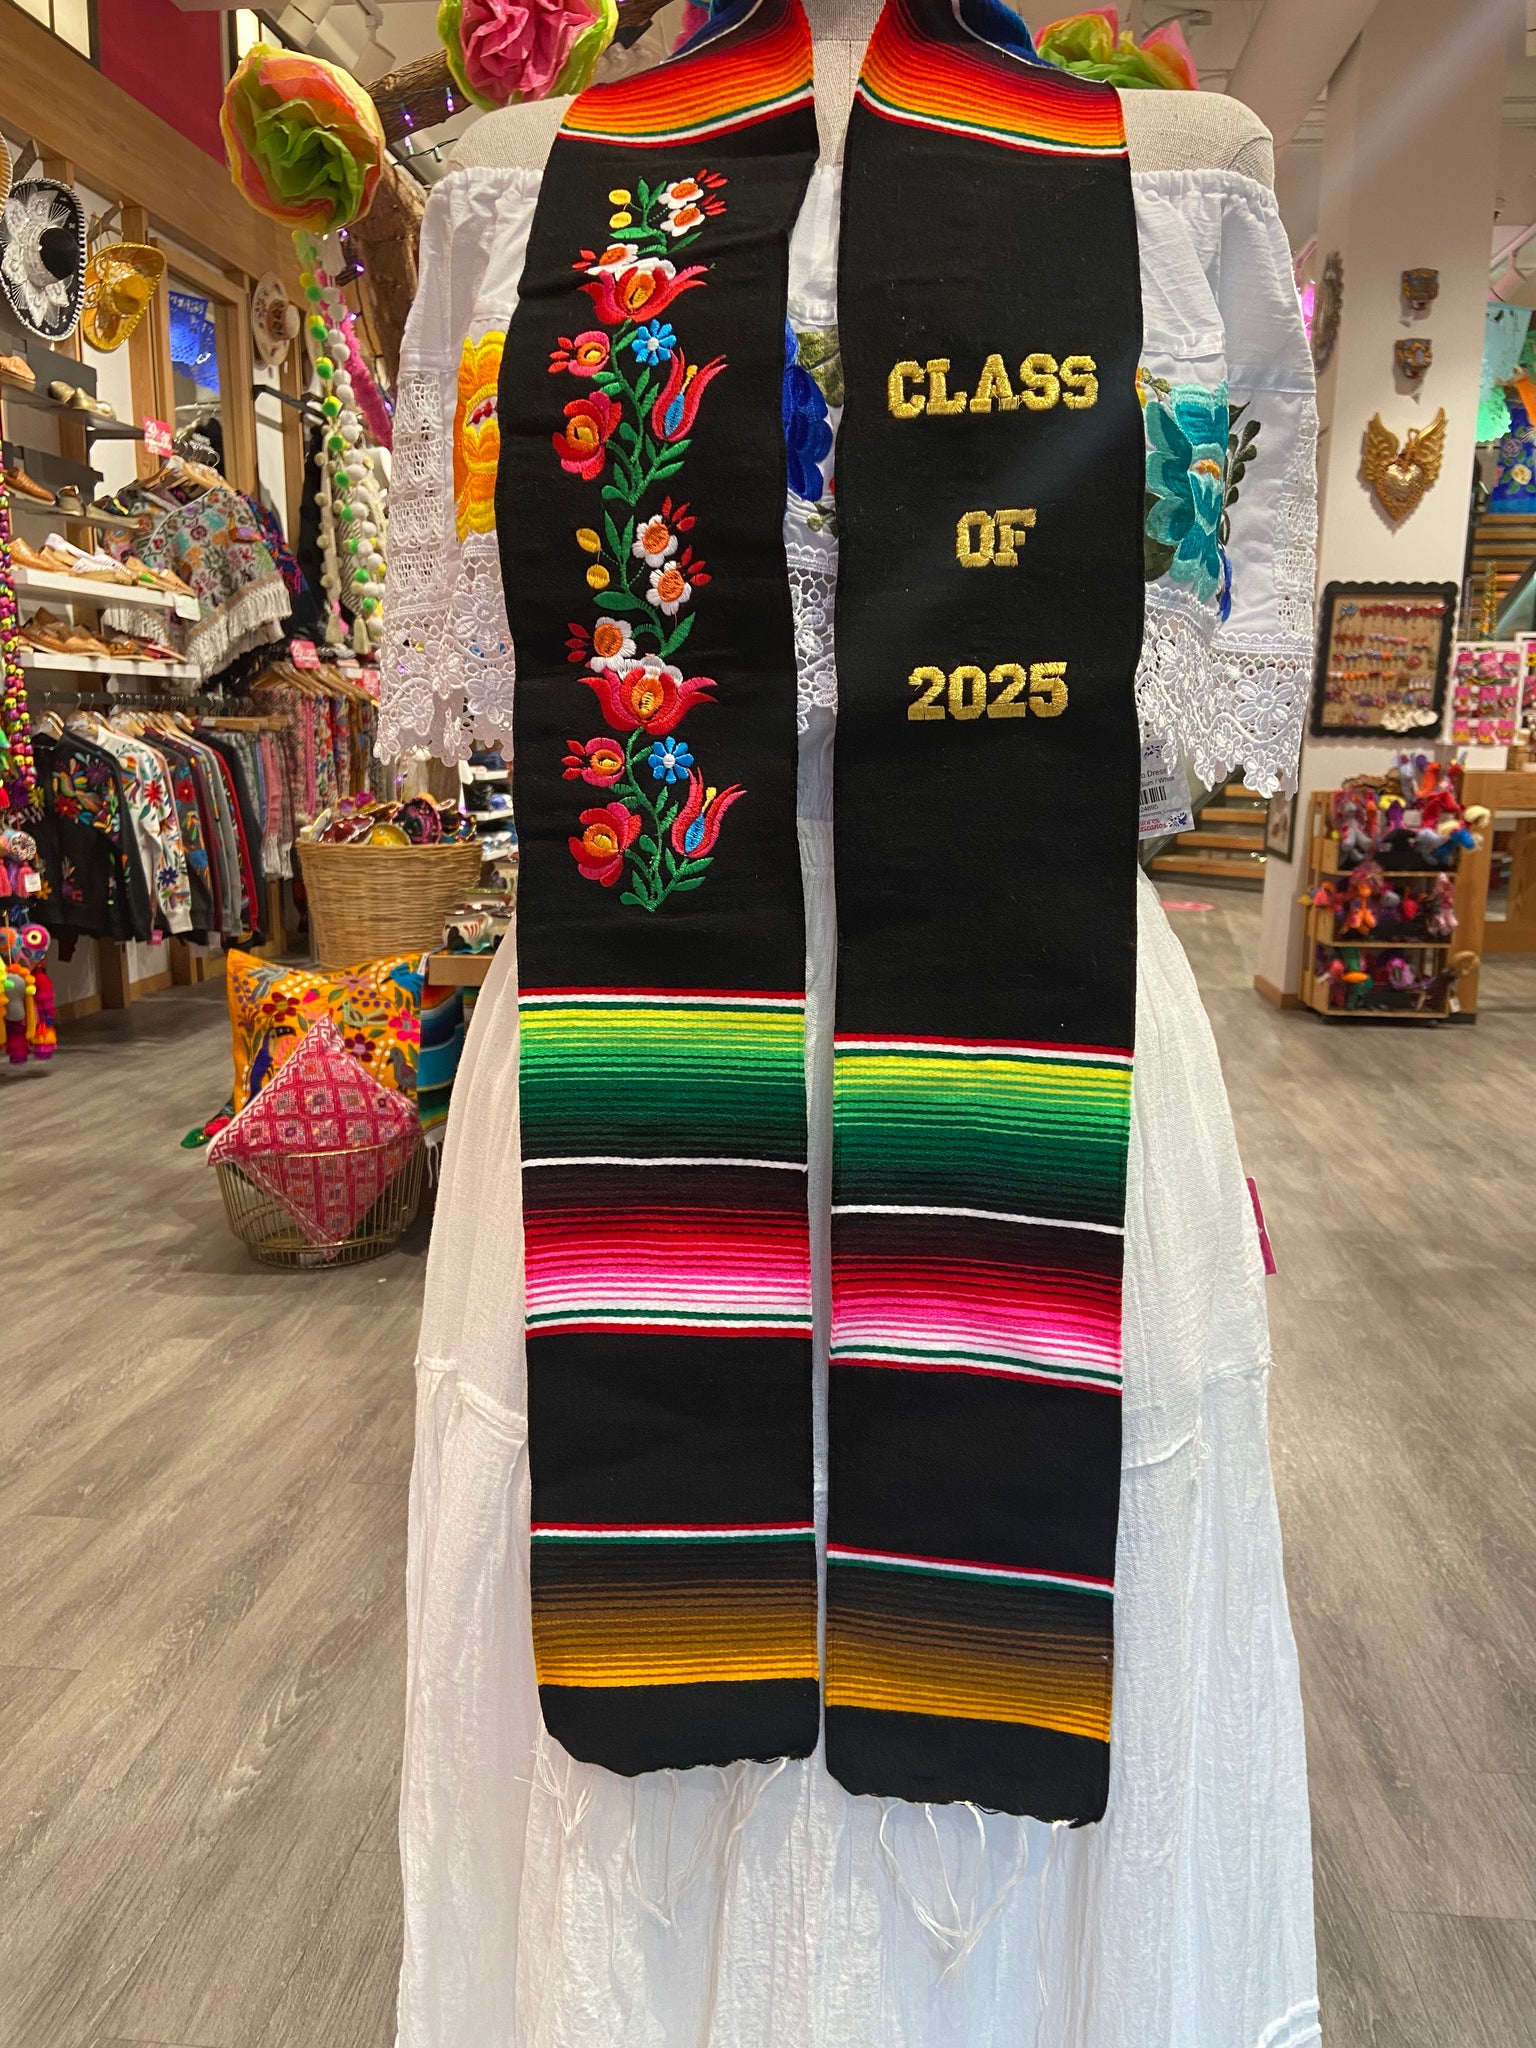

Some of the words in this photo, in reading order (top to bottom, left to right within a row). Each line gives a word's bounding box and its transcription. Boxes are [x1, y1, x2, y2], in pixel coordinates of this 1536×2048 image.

[887, 352, 1099, 419] CLASS
[956, 508, 1037, 568] OF
[907, 661, 1069, 720] 2025
[1140, 804, 1159, 813] 24895
